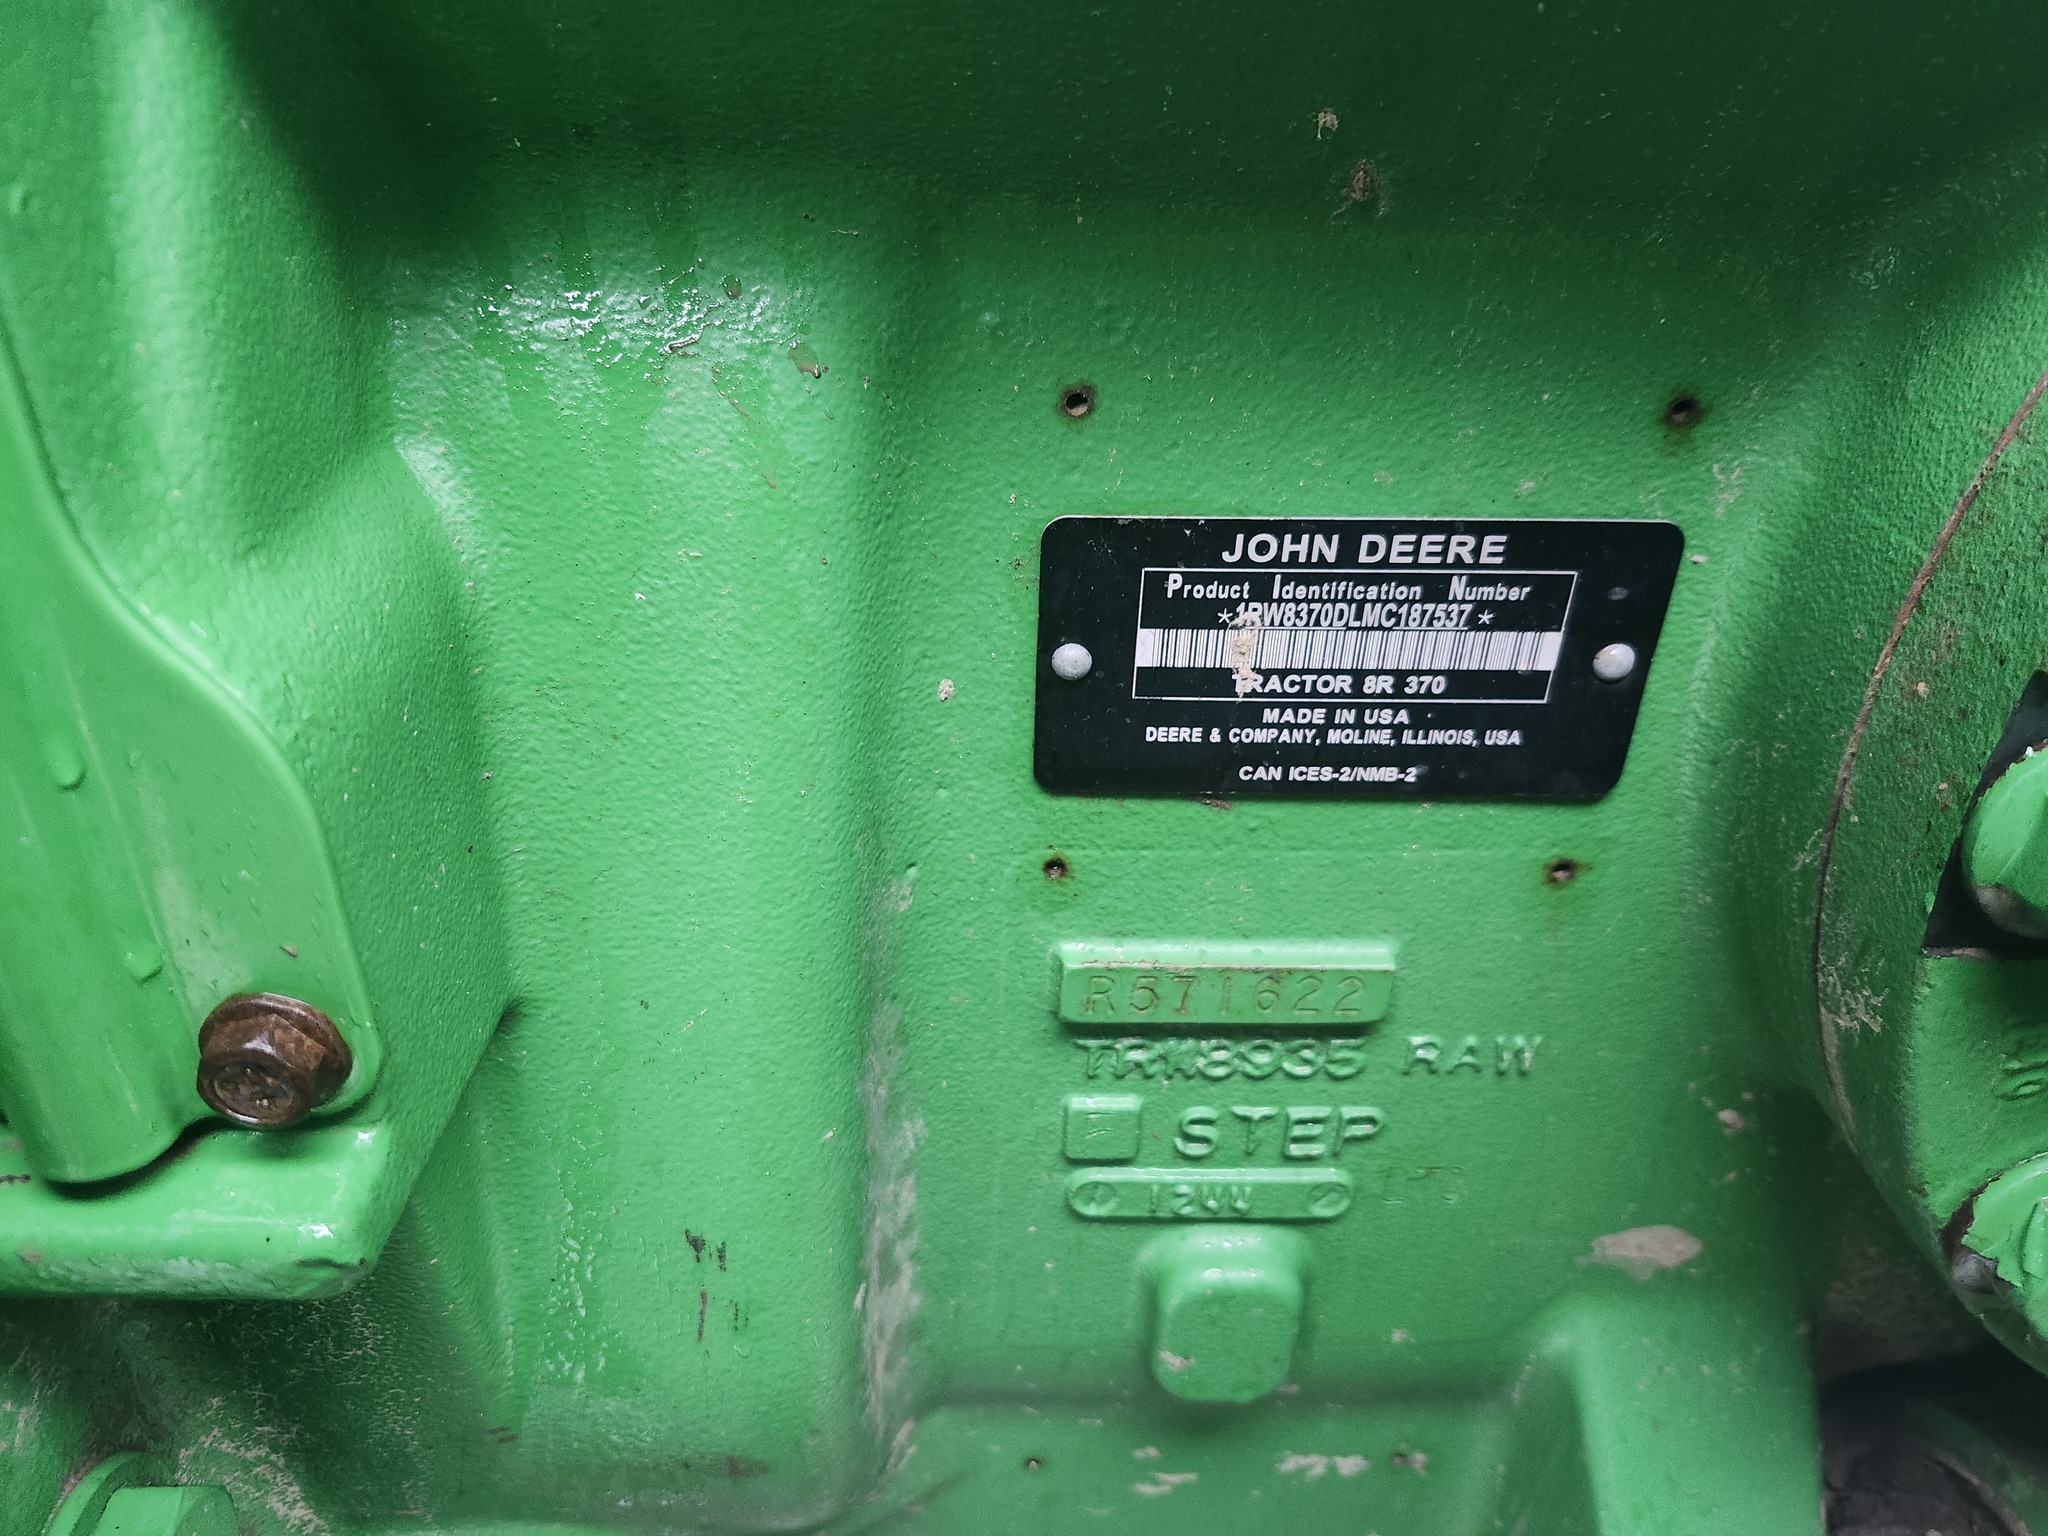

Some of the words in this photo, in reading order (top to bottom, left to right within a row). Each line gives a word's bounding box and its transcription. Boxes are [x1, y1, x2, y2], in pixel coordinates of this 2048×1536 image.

[1222, 534, 1340, 564] JOHN
[1358, 534, 1508, 565] DEERE
[1166, 574, 1250, 600] Product
[1272, 574, 1422, 600] Identification
[1448, 574, 1530, 601] Number
[1232, 674, 1352, 695] TRACTOR
[1362, 674, 1394, 696] 8R
[1403, 675, 1447, 696] 370
[1262, 708, 1325, 724] MADE
[1334, 708, 1357, 724] IN
[1364, 708, 1410, 726] USA
[1145, 727, 1202, 743] DEERE
[1209, 728, 1221, 743] &
[1228, 728, 1320, 745] COMPANY,
[1327, 729, 1395, 746] MOLINE,
[1402, 730, 1478, 747] ILLINOIS,
[1485, 731, 1521, 746] USA
[1239, 766, 1282, 782] CAN
[1288, 766, 1418, 783] ICES-2/NMB-2
[1085, 975, 1366, 1015] R571622
[1404, 1034, 1542, 1077] RAW
[1174, 1106, 1384, 1159] STEP
